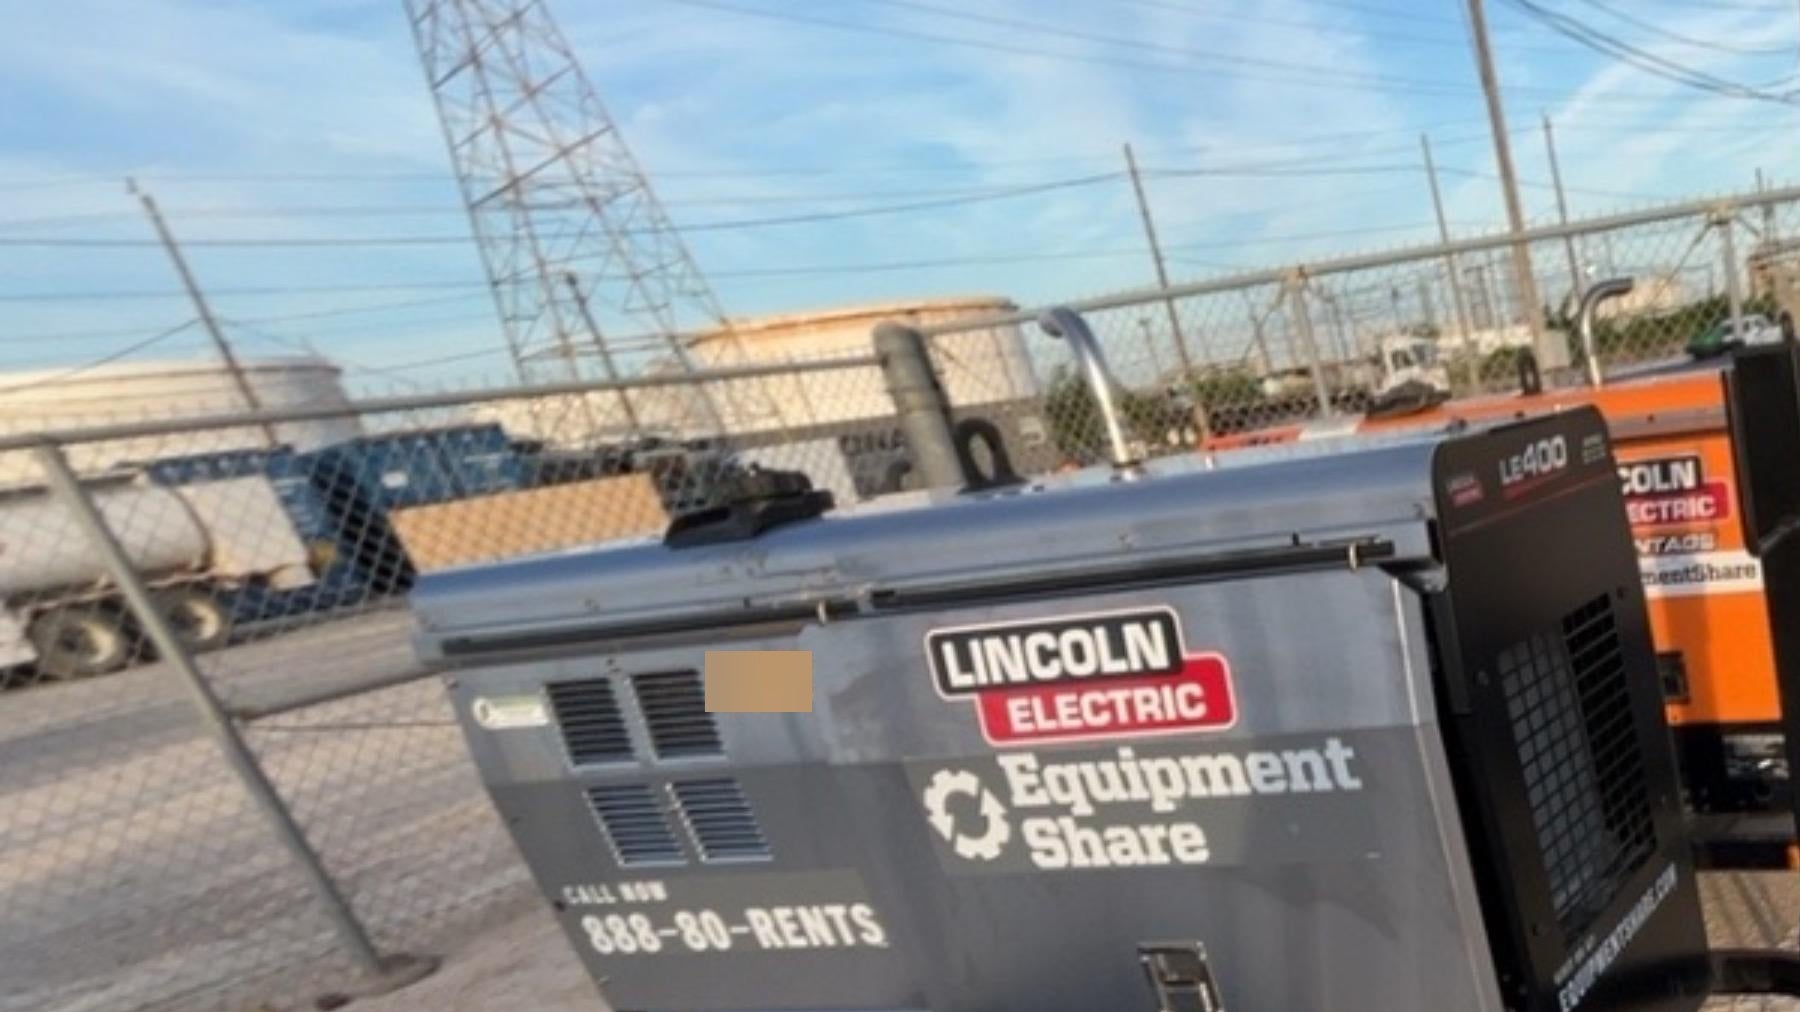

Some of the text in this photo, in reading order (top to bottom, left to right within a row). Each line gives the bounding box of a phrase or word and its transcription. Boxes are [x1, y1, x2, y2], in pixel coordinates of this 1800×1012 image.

[1499, 436, 1568, 486] LE400
[942, 620, 1169, 688] LINCOLN
[1007, 682, 1207, 734] ELECTRIC
[997, 737, 1362, 815] Equipment
[1021, 817, 1211, 870] Share
[562, 881, 668, 905] CALL NOW
[581, 903, 887, 955] 888-80-RENTS
